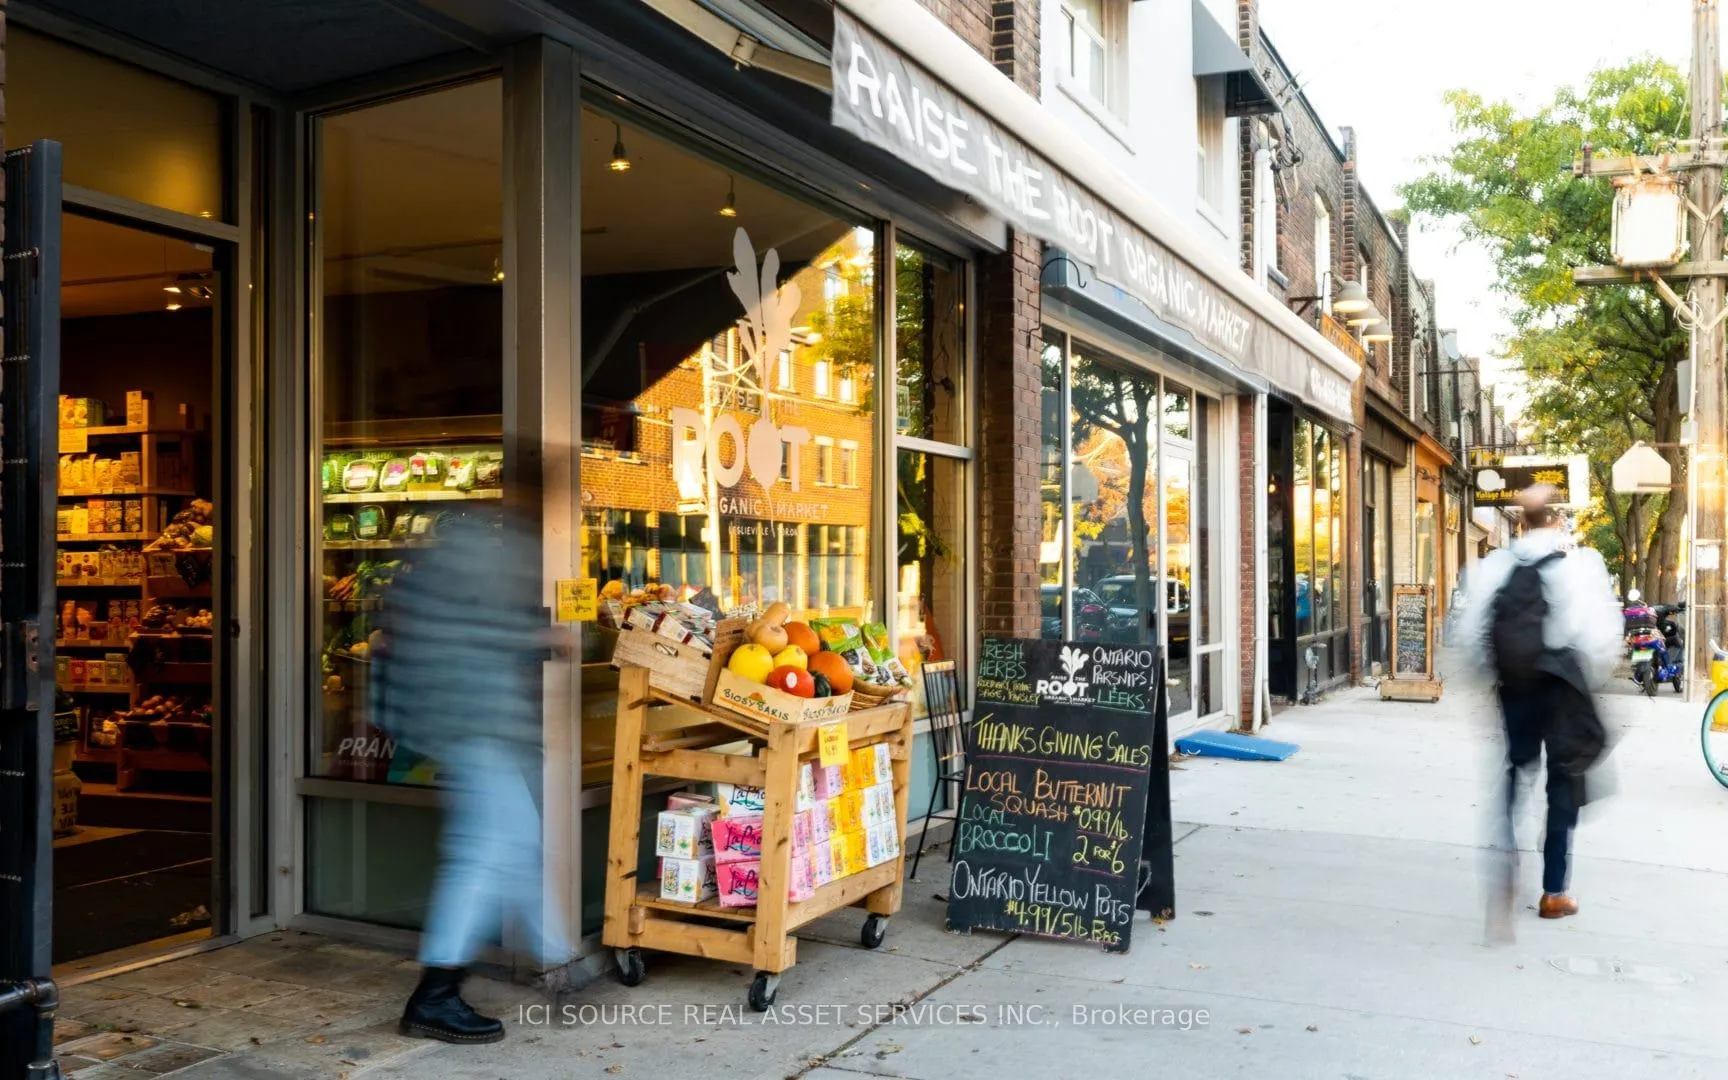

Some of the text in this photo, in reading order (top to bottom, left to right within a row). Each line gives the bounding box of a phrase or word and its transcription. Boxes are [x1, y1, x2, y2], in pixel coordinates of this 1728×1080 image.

[848, 41, 978, 175] RAISE
[982, 136, 1050, 220] THE
[1052, 184, 1113, 265] ROOT
[1124, 237, 1195, 318] ORGANIC
[1197, 289, 1250, 354] MARKET
[983, 638, 1024, 660] FRESH
[1092, 646, 1152, 668] ONTARIO
[979, 659, 1027, 680] HERBS
[1036, 679, 1089, 697] ROOT
[1097, 689, 1145, 710] LEEKS
[1107, 731, 1151, 766] SALES
[966, 764, 1132, 808] LOCAL BUTTERNUT
[961, 796, 1016, 826] LOCAL
[991, 793, 1069, 822] SQUASH
[959, 822, 1054, 861] BROCCOLI
[1072, 835, 1090, 865] 2
[1093, 847, 1112, 861] FOR
[952, 860, 1131, 925] ONTARIO YELLOW POTS
[1091, 920, 1122, 944] BAG
